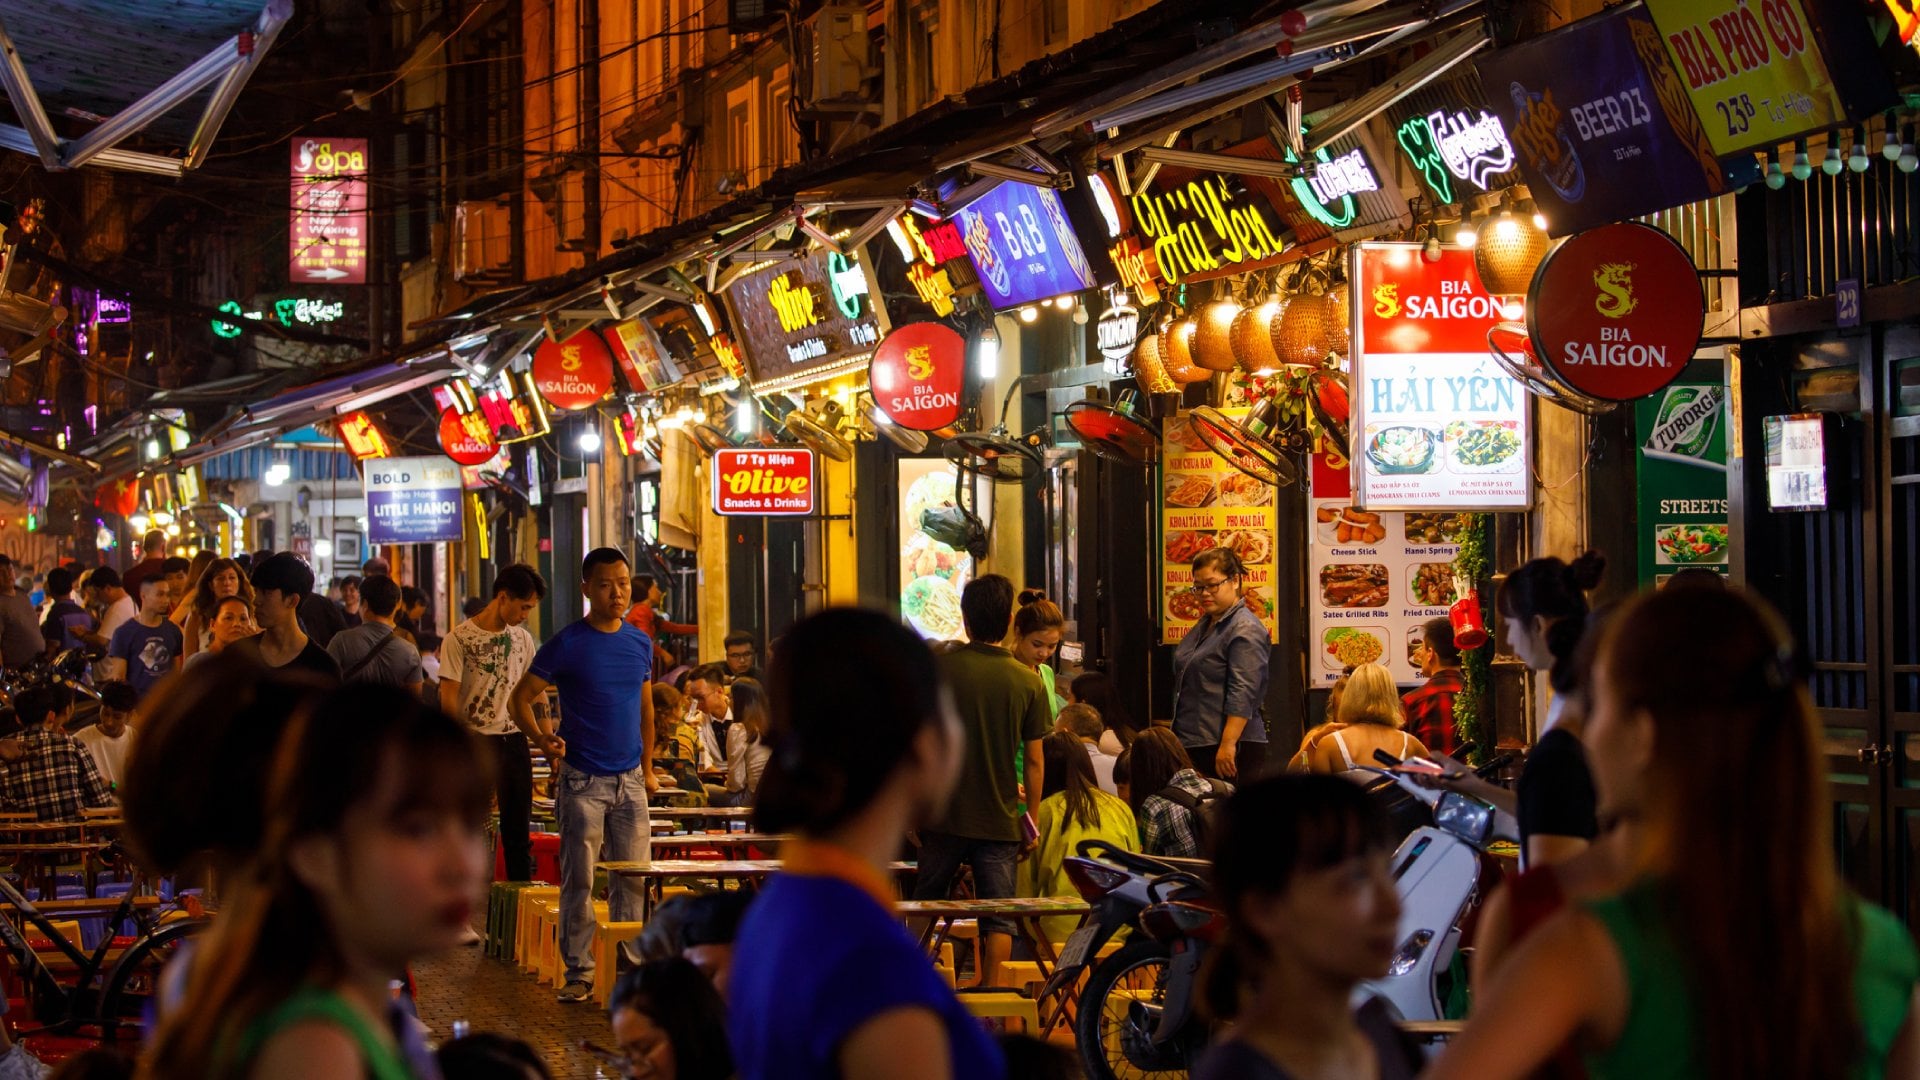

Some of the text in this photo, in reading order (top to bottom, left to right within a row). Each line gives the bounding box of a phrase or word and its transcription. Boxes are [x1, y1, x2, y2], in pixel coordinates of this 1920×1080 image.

[1669, 25, 1727, 89] BIA
[1570, 87, 1652, 141] BEER 23
[315, 143, 366, 177] Spa
[308, 225, 358, 237] Waxing
[1441, 281, 1473, 295] BIA
[1405, 296, 1507, 319] SAIGON
[1838, 288, 1858, 320] 23
[1600, 327, 1632, 341] BIA
[1564, 342, 1667, 367] SAIGON
[545, 381, 597, 394] SAIGON
[913, 385, 934, 395] BIA
[1371, 360, 1516, 414] HẢI YẾN
[892, 392, 958, 412] SAIGON
[1656, 394, 1714, 450] TUBORG
[736, 454, 795, 467] 17 Tạ Hiện
[373, 472, 411, 485] BOLD
[722, 468, 808, 495] Olive
[374, 501, 456, 517] LITTLE HANOI
[724, 498, 807, 508] Snacks & Drinks
[1169, 515, 1189, 528] KHOAI
[1358, 547, 1377, 555] Stick
[1405, 547, 1426, 555] Hanoi
[1429, 546, 1452, 556] Spring
[1346, 610, 1370, 618] Grilled
[1372, 610, 1389, 618] Ribs
[1403, 608, 1449, 617] Fried Chicke
